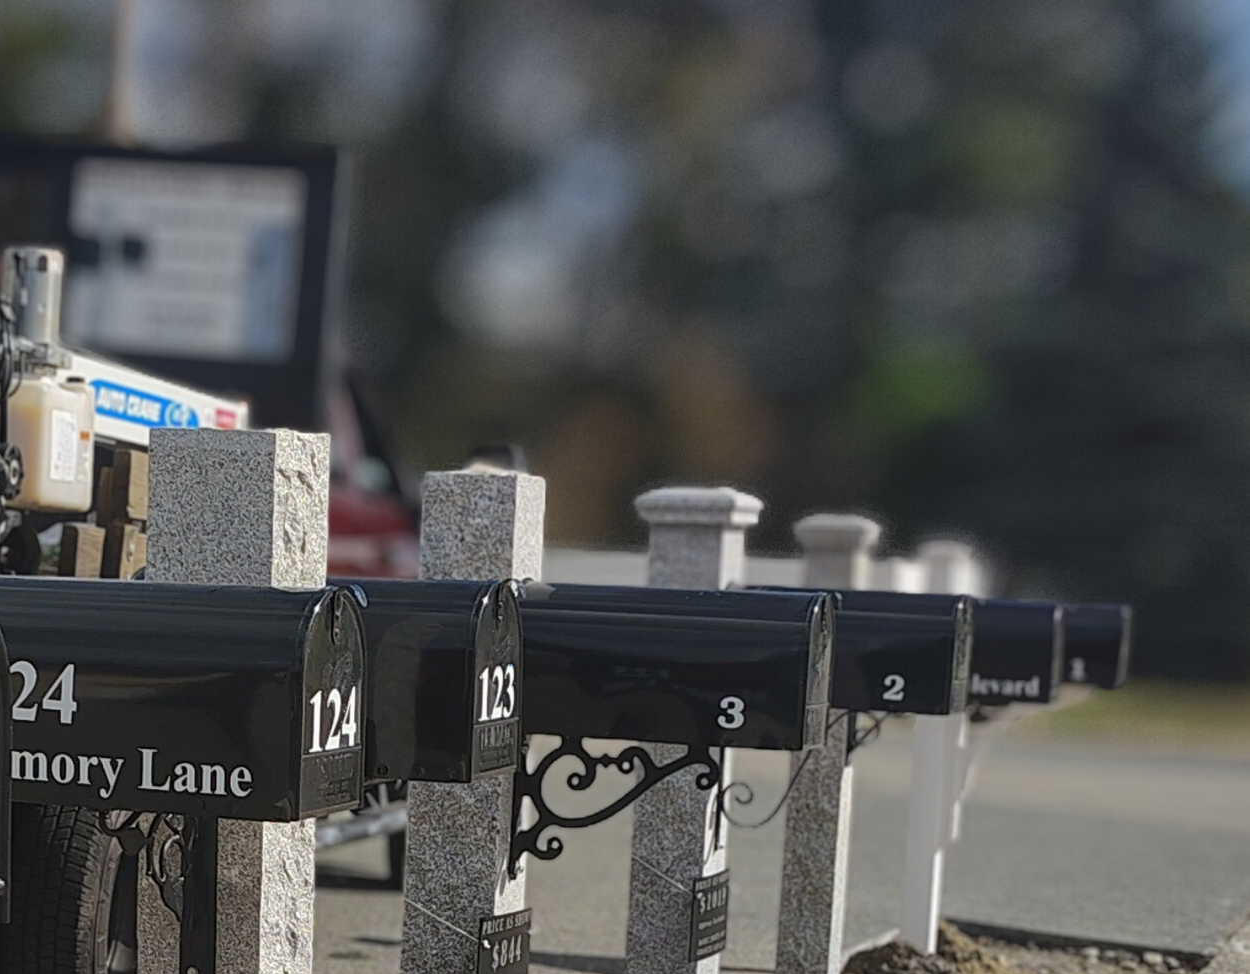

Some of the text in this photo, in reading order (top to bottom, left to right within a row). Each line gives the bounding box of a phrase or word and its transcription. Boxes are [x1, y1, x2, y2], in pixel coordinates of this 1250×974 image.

[477, 663, 516, 722] 123
[882, 674, 905, 701] 2
[308, 685, 357, 753] 124
[716, 696, 746, 730] 3
[137, 748, 253, 797] Lane
[492, 934, 522, 973] $844
